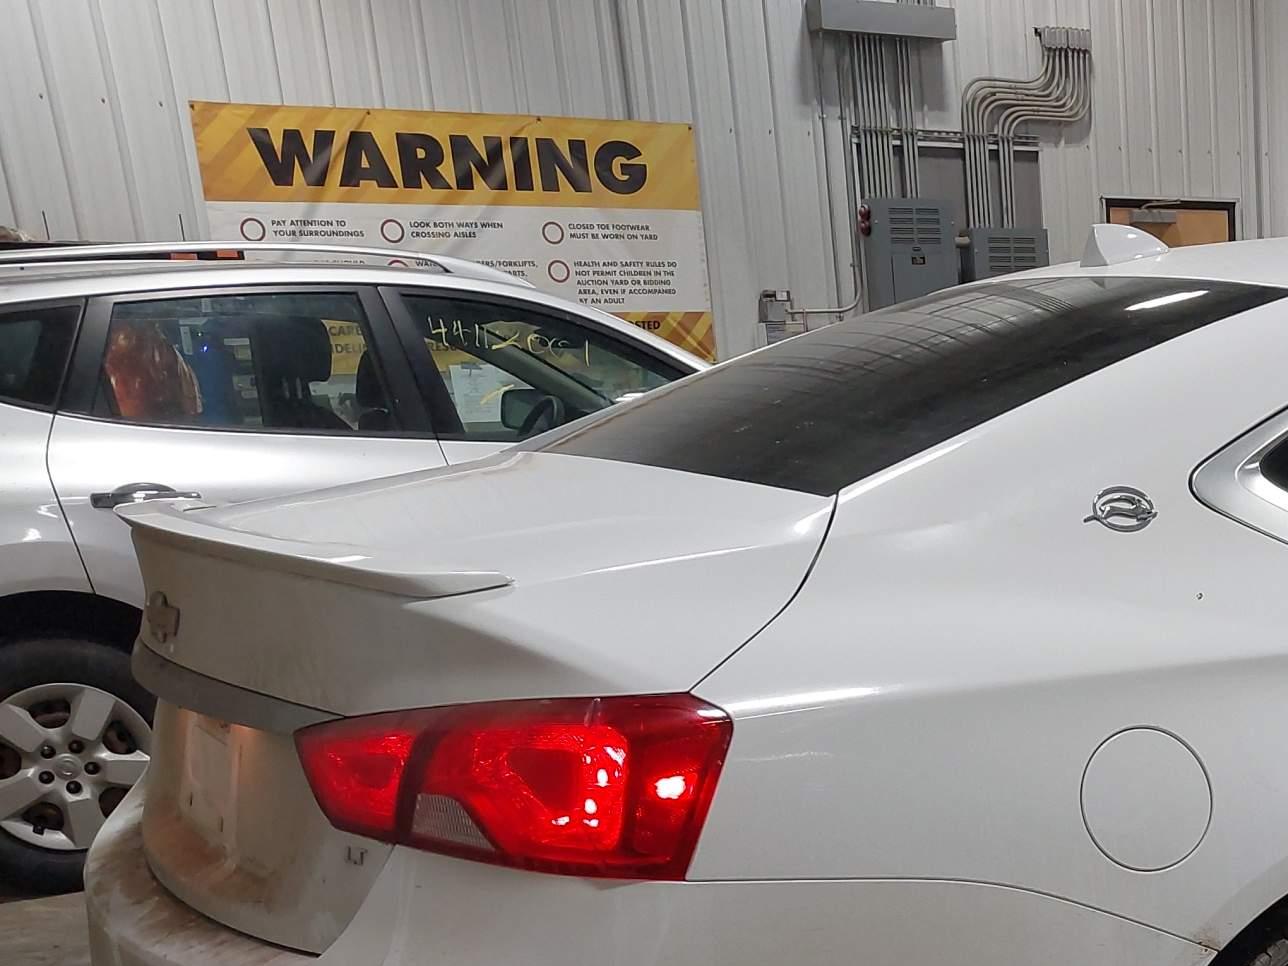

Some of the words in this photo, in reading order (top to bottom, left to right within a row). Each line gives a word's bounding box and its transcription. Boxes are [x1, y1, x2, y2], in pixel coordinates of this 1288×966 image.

[246, 127, 648, 195] WARNING
[409, 221, 431, 229] LOOK
[433, 221, 454, 229] BOTH
[456, 221, 478, 229] WAYS
[612, 223, 650, 231] FOOTWEAR
[411, 231, 451, 239] CROSSING
[640, 233, 658, 241] YARD
[347, 846, 368, 866] LT
